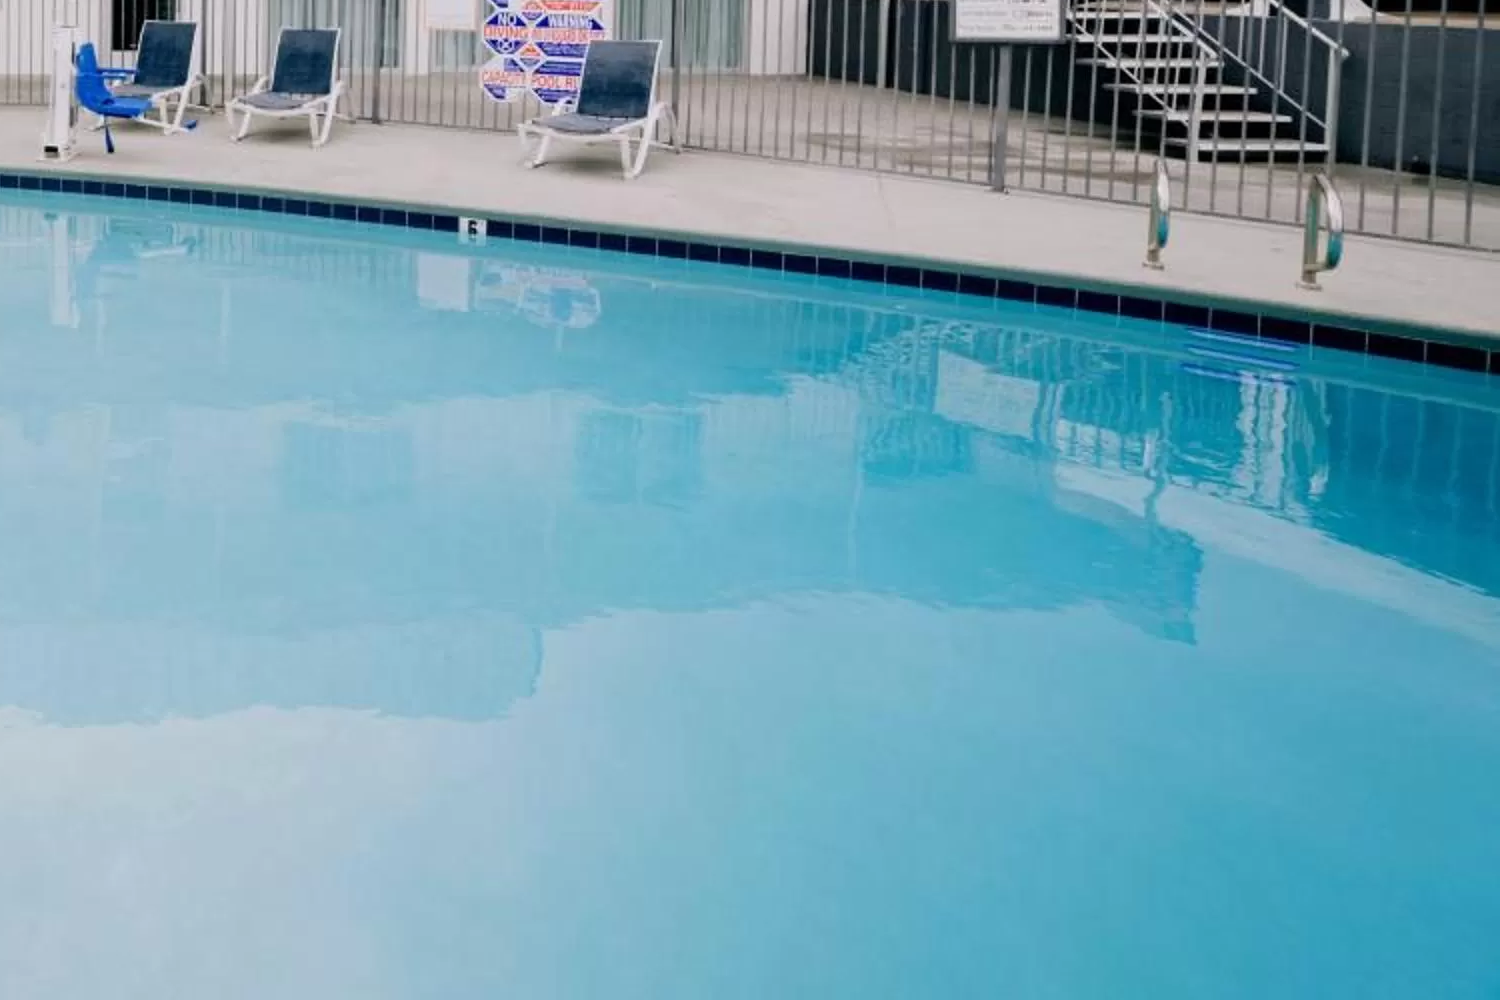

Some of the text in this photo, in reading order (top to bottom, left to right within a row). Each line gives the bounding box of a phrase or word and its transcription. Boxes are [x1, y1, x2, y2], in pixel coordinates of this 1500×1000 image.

[498, 12, 516, 26] NO
[548, 13, 593, 29] WARNING
[484, 26, 529, 39] DIVING
[531, 74, 562, 89] POOL
